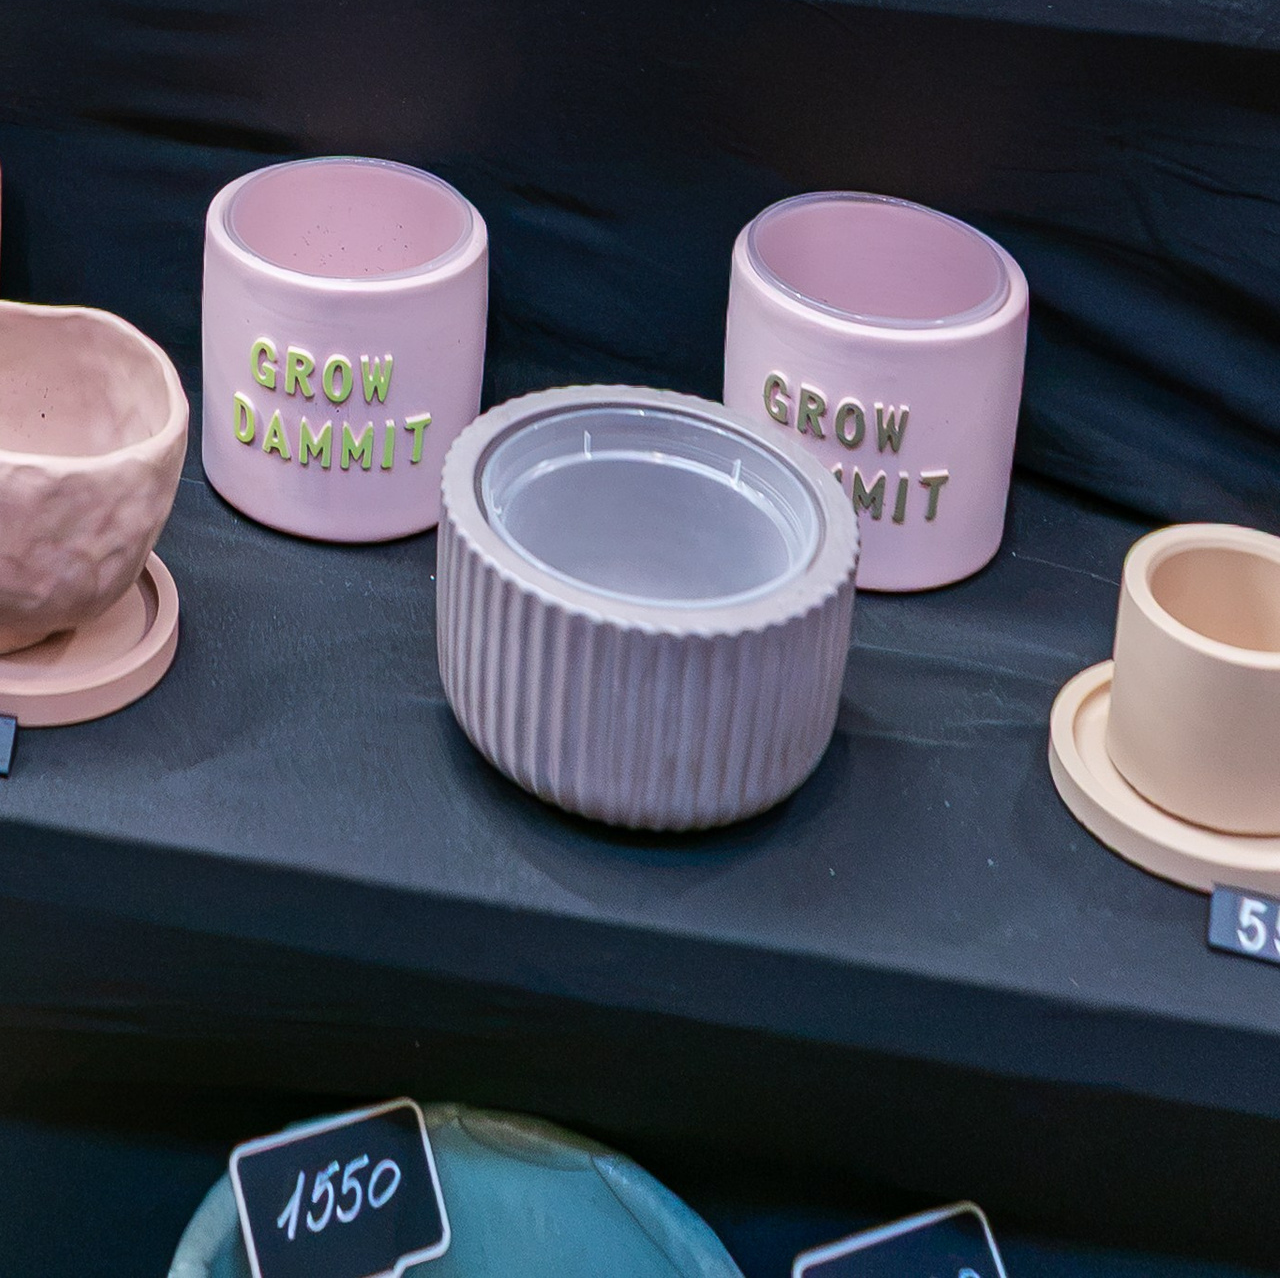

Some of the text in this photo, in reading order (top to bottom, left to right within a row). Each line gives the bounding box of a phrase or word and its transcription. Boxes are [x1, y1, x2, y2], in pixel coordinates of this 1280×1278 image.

[249, 337, 395, 405] GROW
[233, 391, 433, 471] DAMMIT
[763, 369, 911, 455] GROW
[830, 461, 951, 525] MIT
[275, 1153, 402, 1241] 1550
